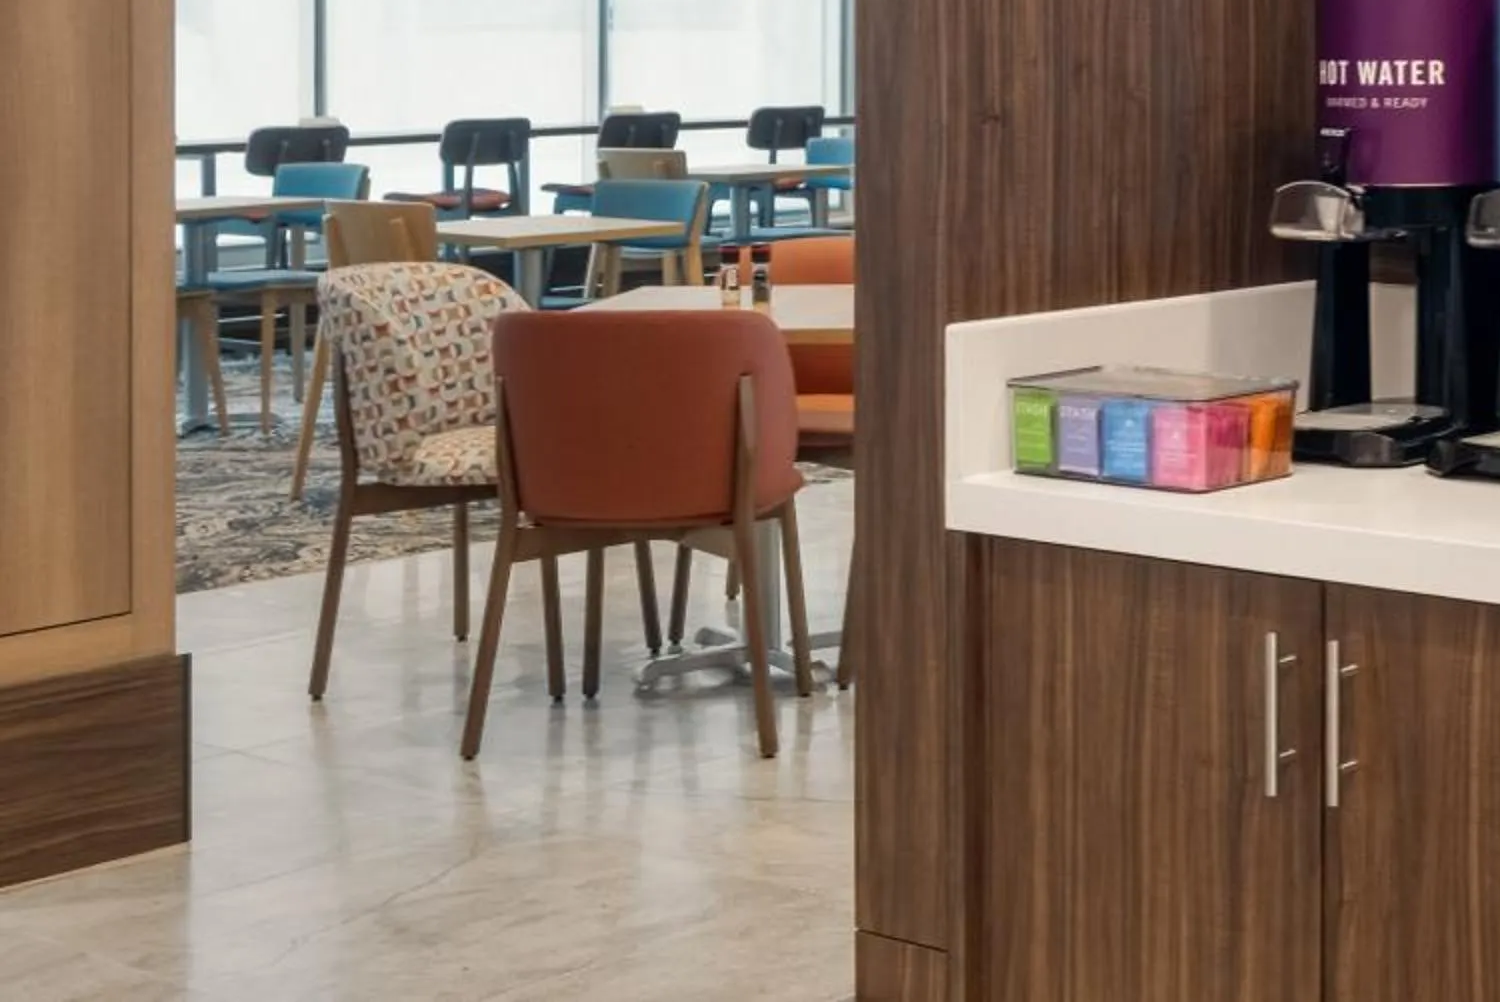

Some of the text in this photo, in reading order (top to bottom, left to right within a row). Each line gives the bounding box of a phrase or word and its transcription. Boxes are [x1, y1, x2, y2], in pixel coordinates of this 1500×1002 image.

[1319, 60, 1446, 86] HOT WATER
[1383, 97, 1428, 109] READY
